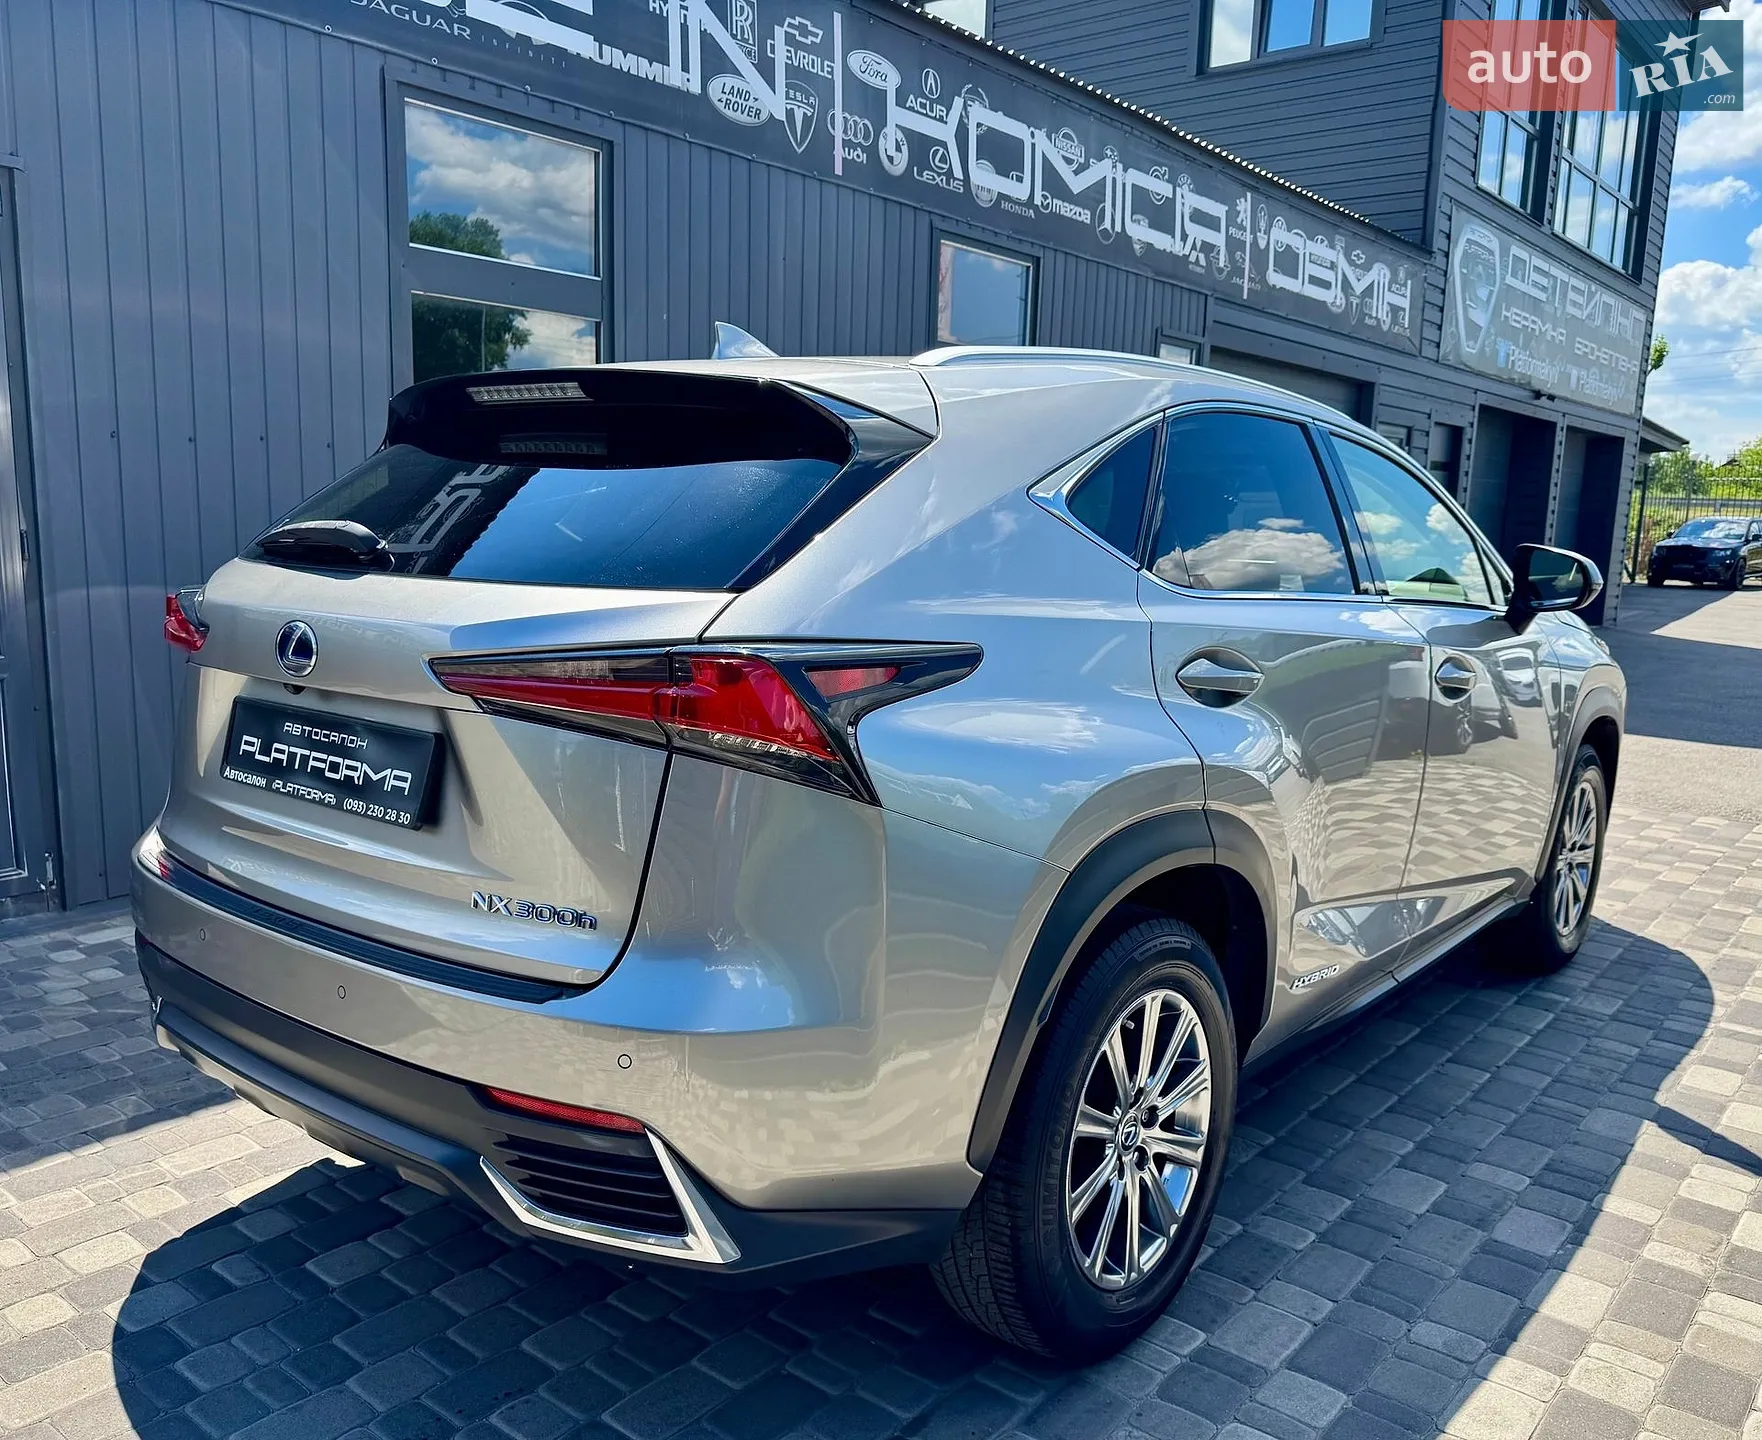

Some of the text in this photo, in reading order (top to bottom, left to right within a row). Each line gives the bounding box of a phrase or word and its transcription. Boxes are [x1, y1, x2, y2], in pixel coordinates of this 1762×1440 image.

[766, 38, 835, 79] CEVROLE
[721, 82, 751, 102] LAND
[724, 97, 762, 121] ROVER
[906, 94, 949, 121] ACUR
[833, 146, 867, 165] udi
[1055, 137, 1081, 158] NISSAN
[914, 166, 964, 193] LEXUS
[1001, 200, 1035, 219] HONDA
[283, 721, 369, 750] АВТОСАЛОН
[239, 734, 413, 796] PLATFORMA
[223, 765, 268, 788] Автосалон
[343, 797, 367, 816] (093)
[367, 802, 385, 818] 230
[386, 808, 398, 822] 28
[398, 811, 411, 825] 30
[1290, 963, 1340, 990] HYBRID
